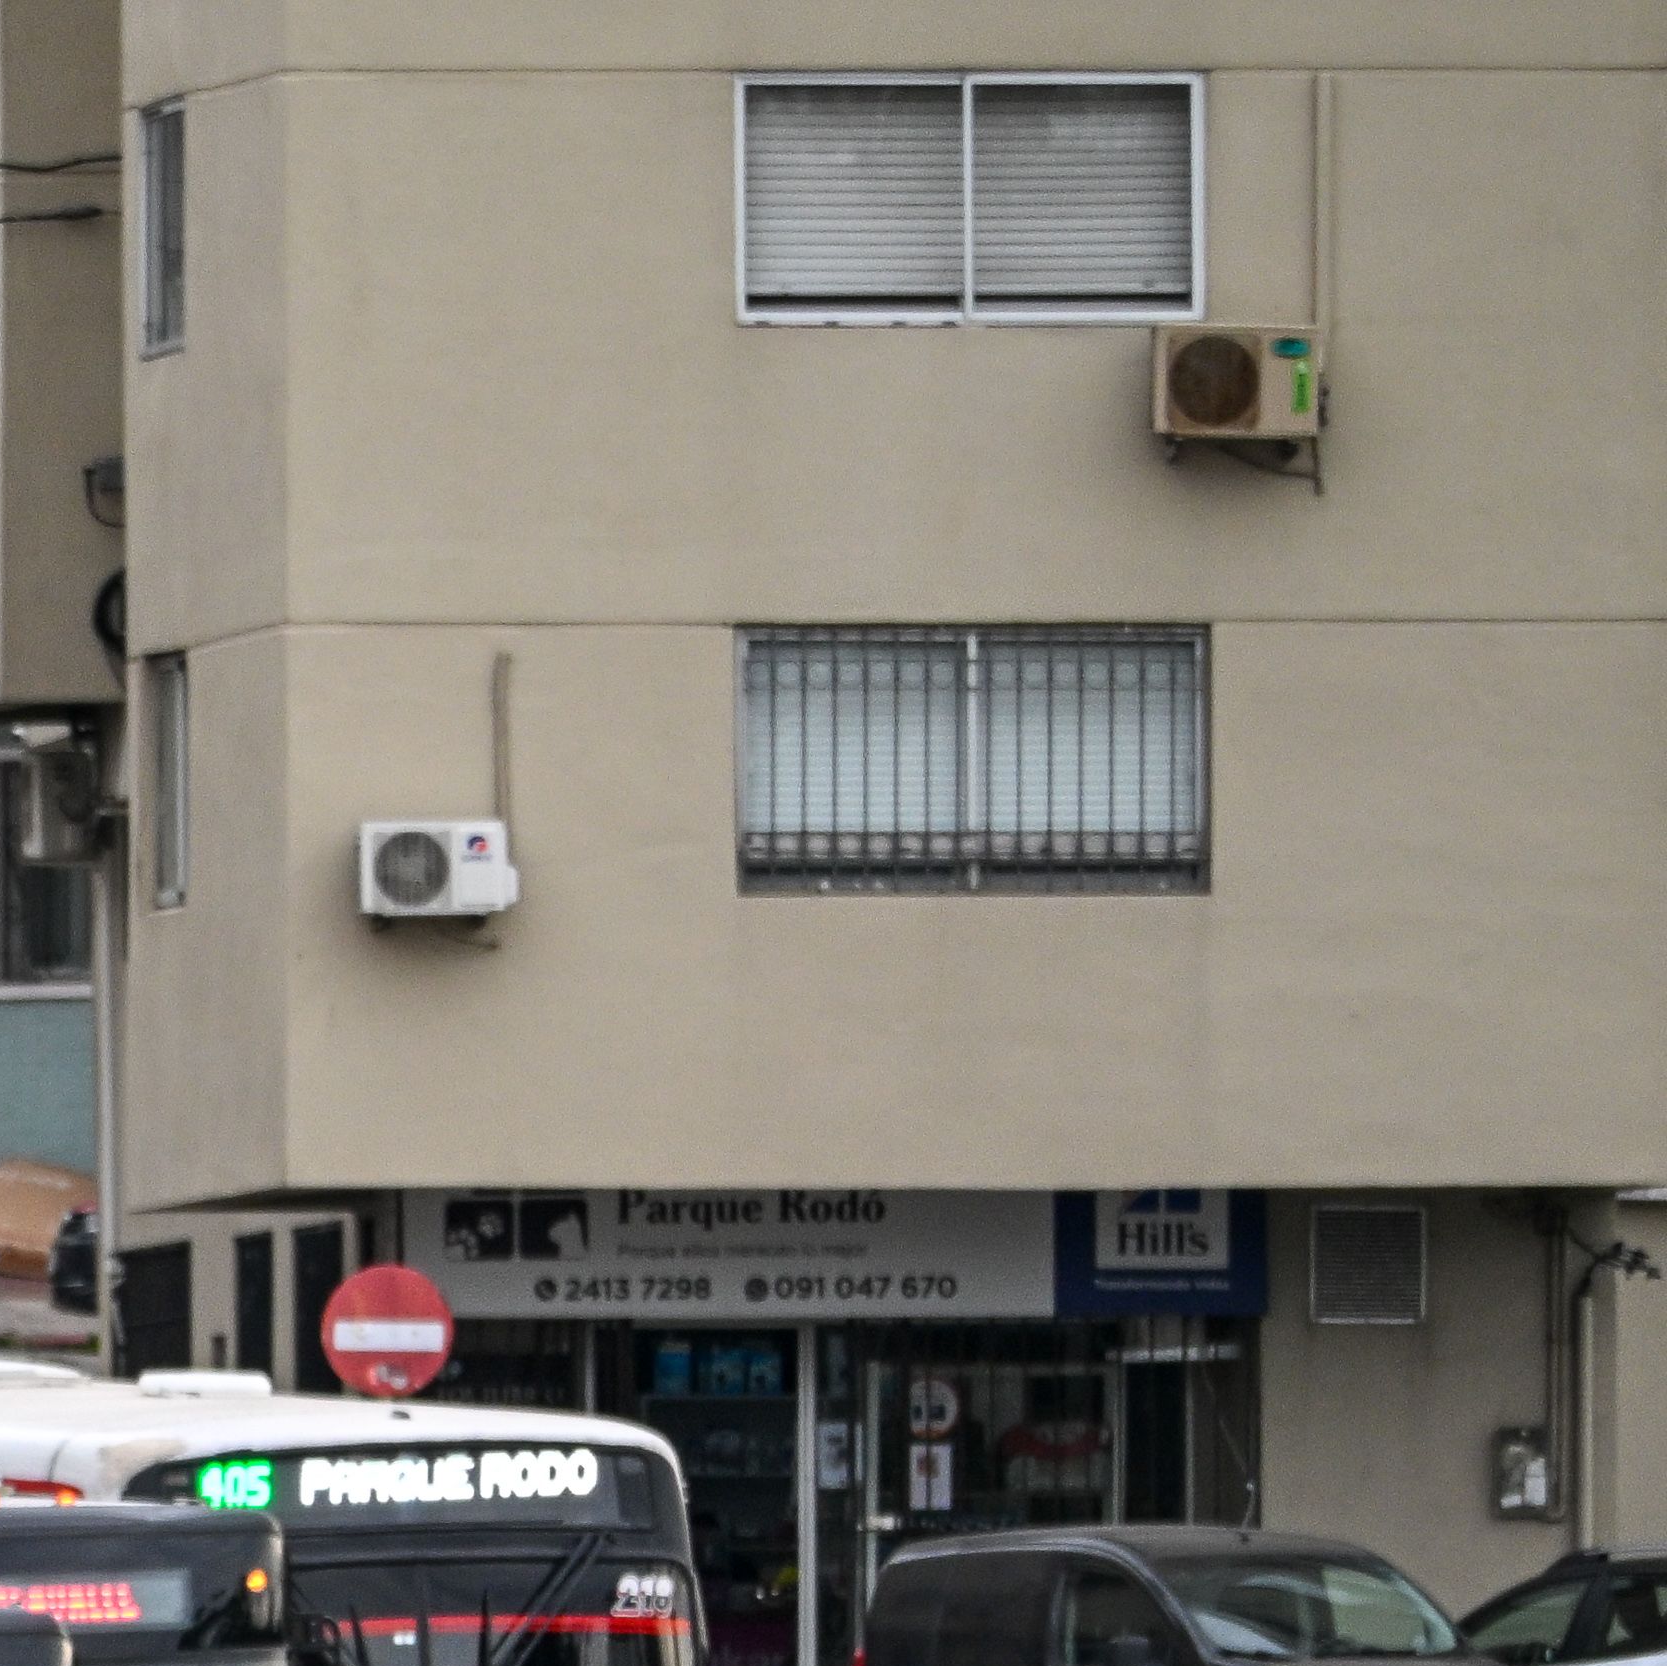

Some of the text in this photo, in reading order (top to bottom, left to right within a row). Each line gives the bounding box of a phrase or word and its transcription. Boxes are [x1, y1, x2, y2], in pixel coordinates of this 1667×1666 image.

[618, 1190, 885, 1231] Parque Rodó
[1119, 1222, 1209, 1256] Hill's
[567, 1277, 712, 1300] 2413 7298
[774, 1276, 958, 1300] 091 047 670
[198, 1460, 271, 1509] 405
